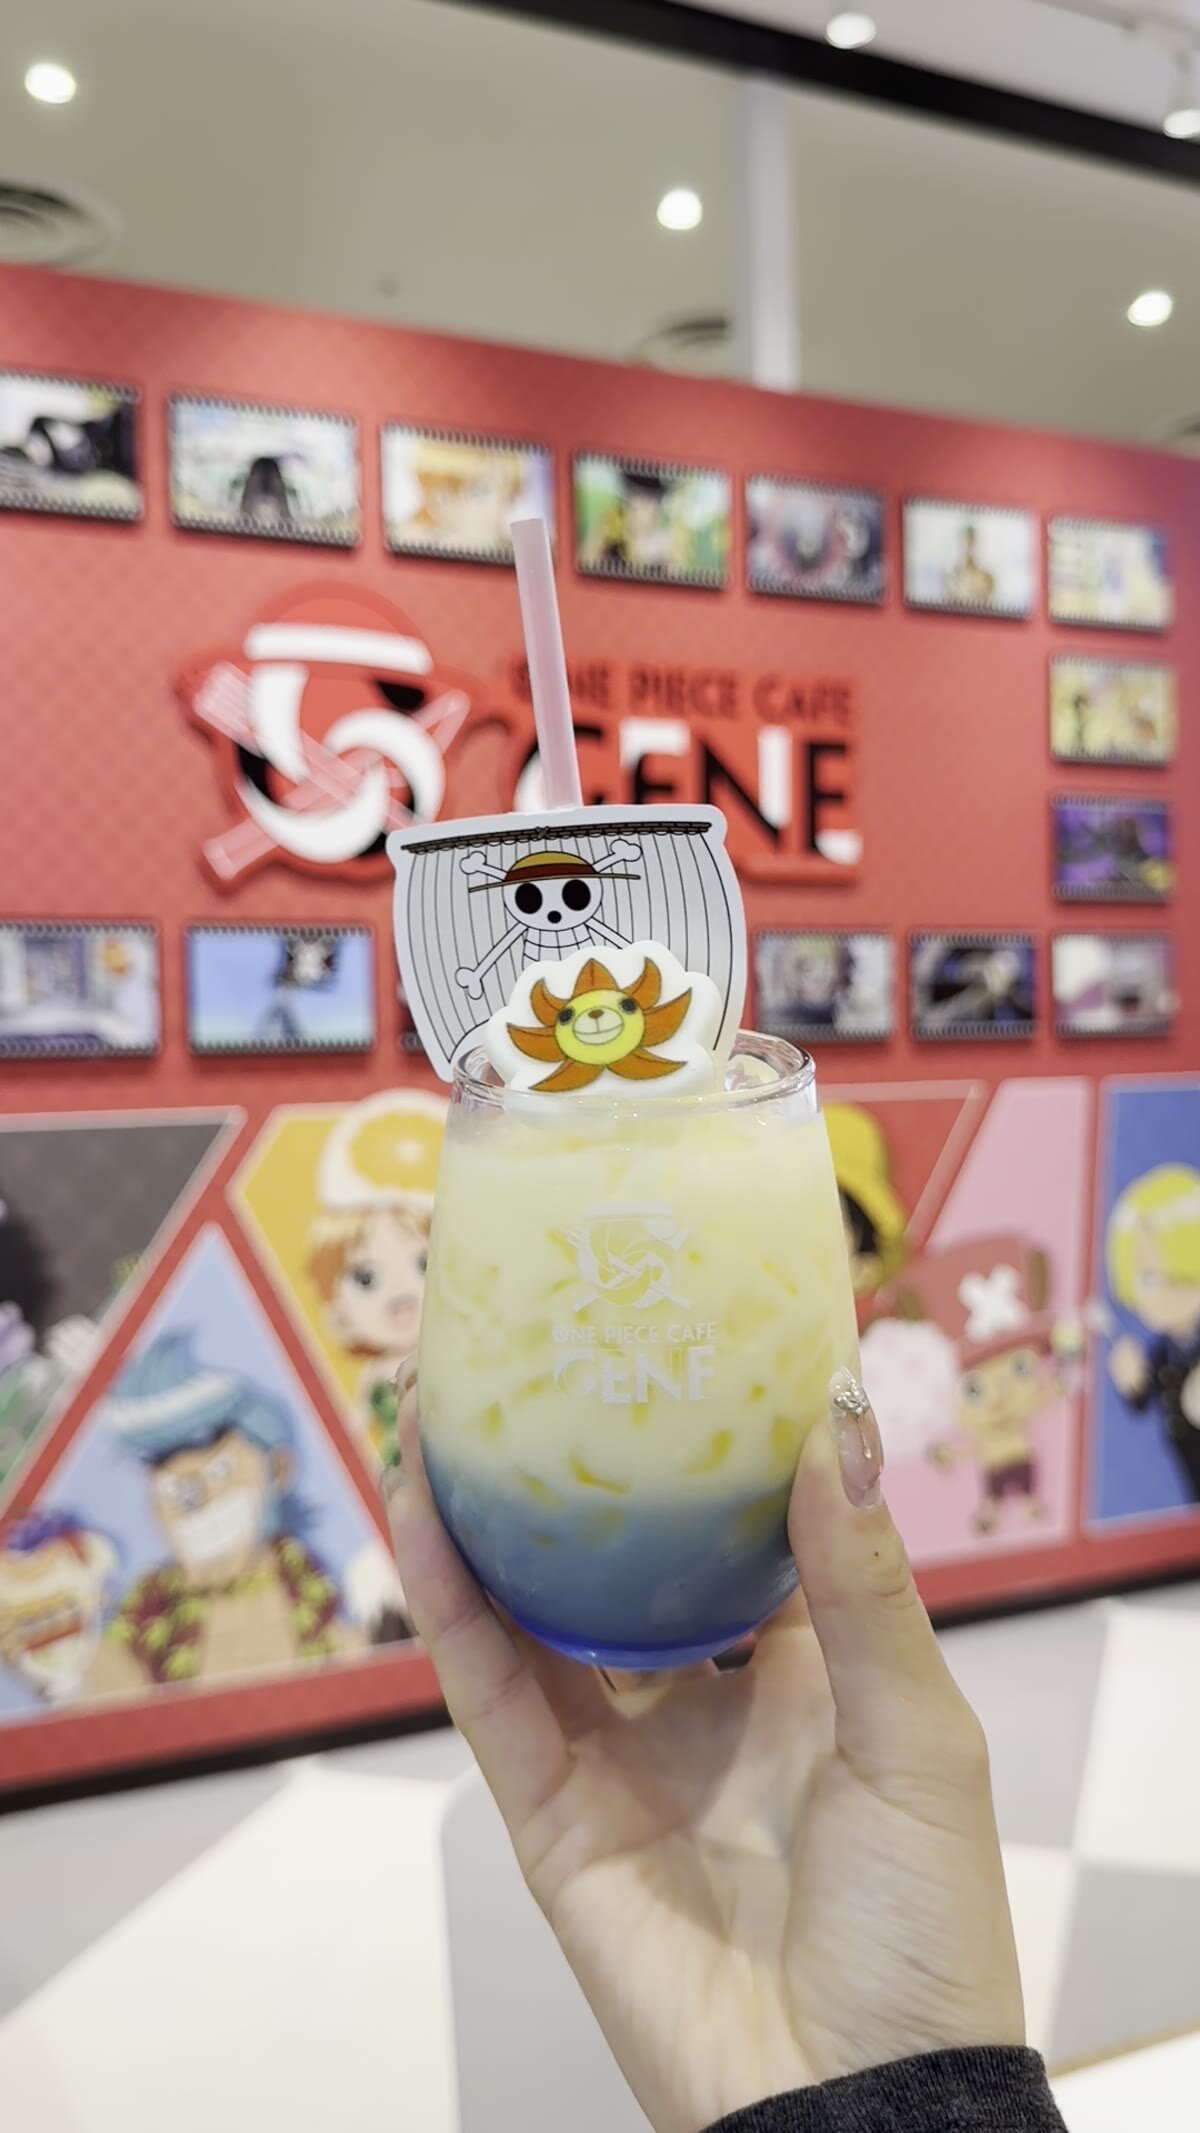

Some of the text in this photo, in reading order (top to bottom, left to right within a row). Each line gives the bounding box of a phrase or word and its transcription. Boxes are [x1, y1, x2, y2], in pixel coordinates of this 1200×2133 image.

[631, 666, 738, 720] PIECE
[752, 674, 852, 725] CAFE
[552, 1320, 718, 1345] ONE PIECE CAFE
[552, 1345, 717, 1405] GENE
